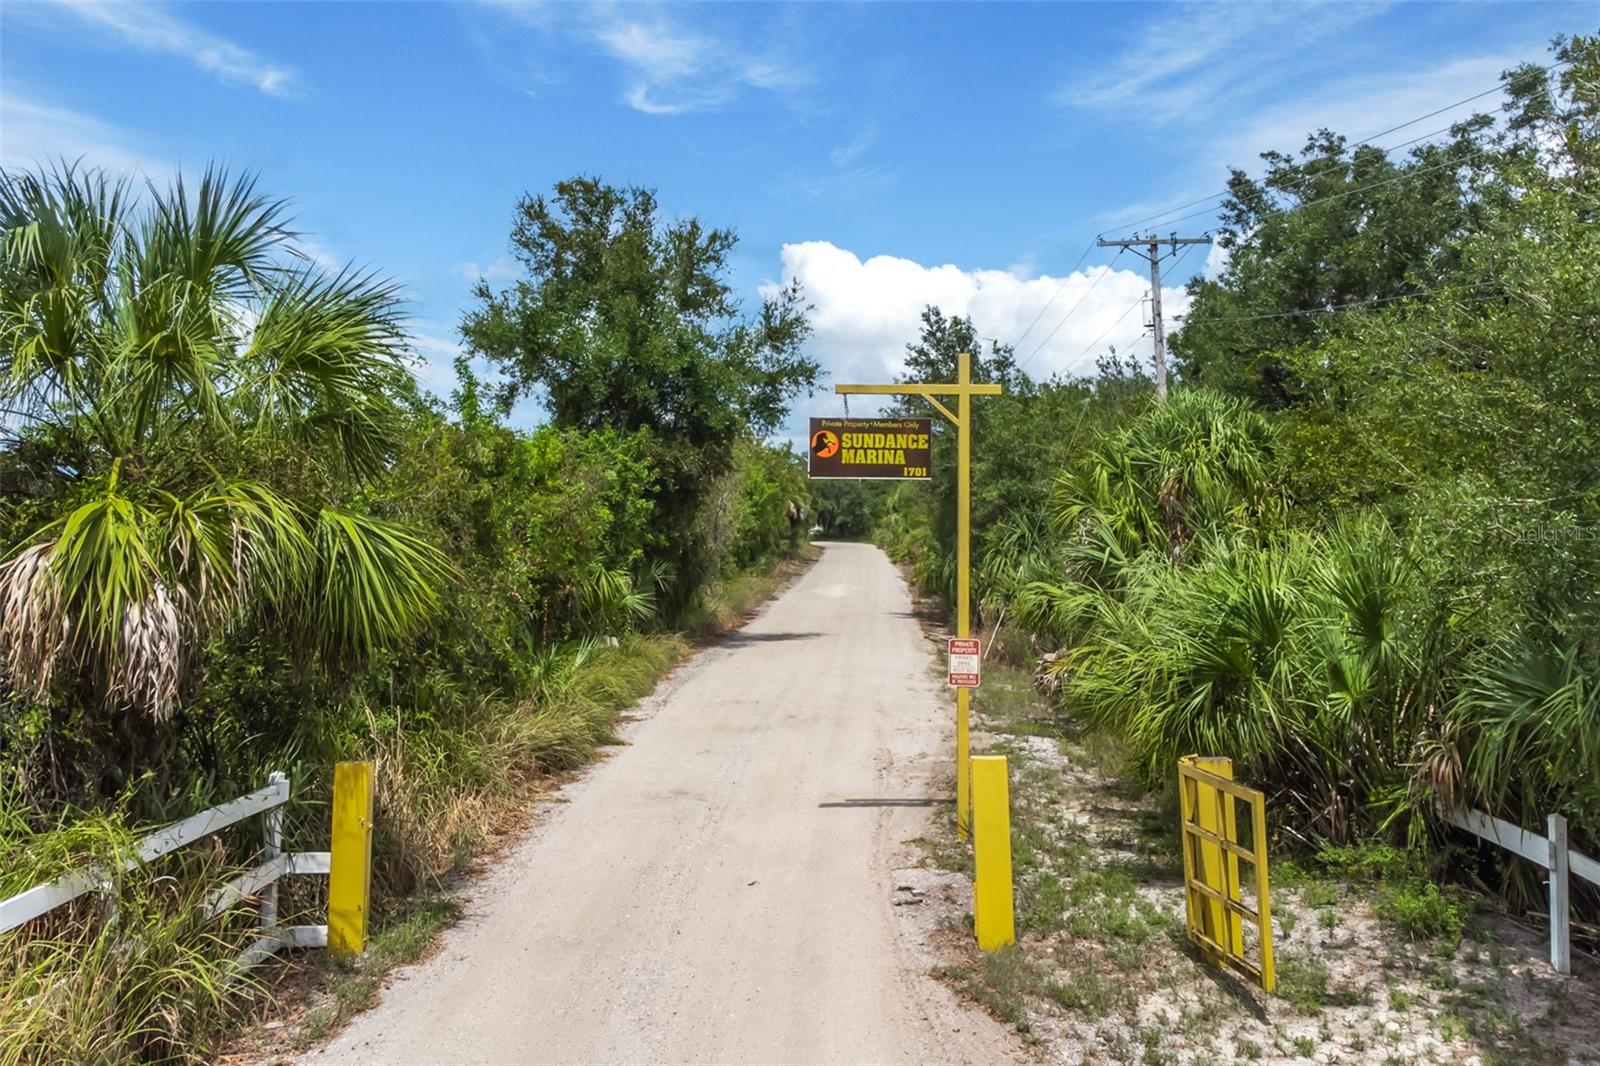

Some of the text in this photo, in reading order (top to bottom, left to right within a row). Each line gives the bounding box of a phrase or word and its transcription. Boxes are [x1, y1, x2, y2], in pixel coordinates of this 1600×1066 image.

[844, 420, 869, 429] Property
[841, 433, 929, 449] SUNDANCE
[841, 449, 906, 464] MARINA
[903, 467, 927, 476] 1701
